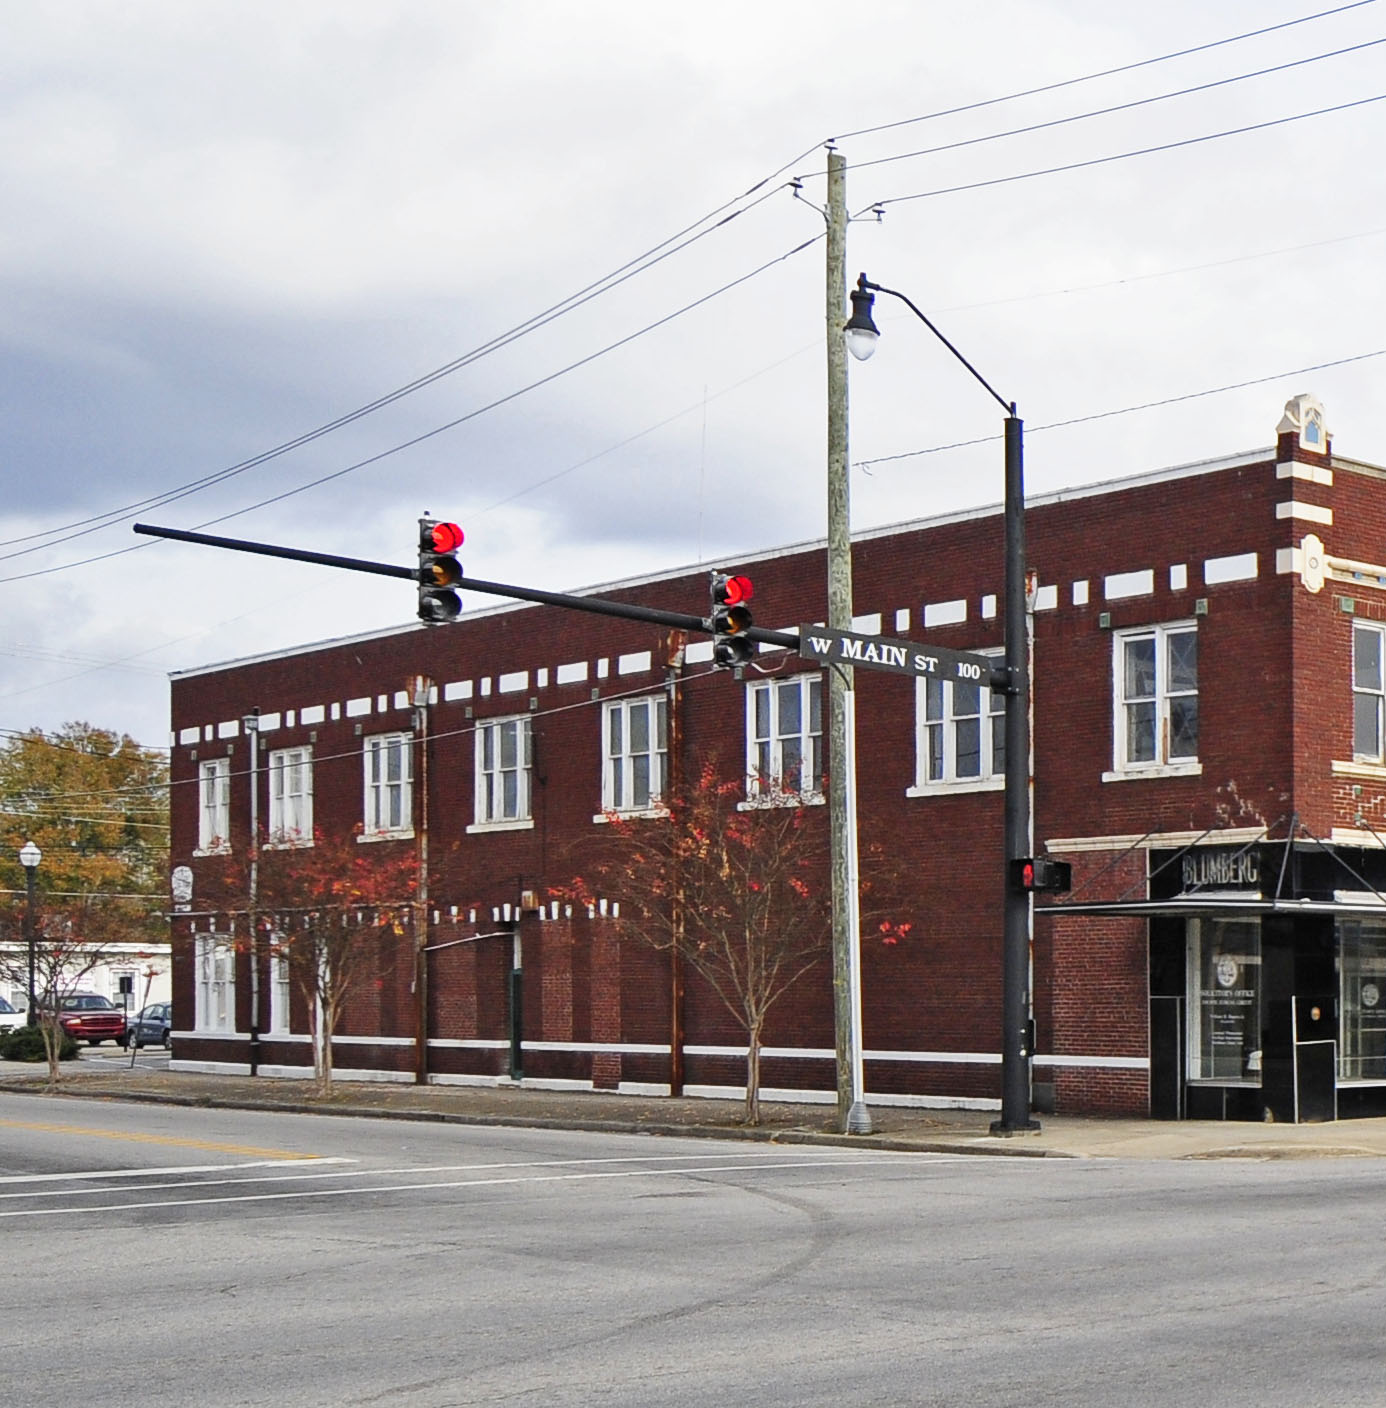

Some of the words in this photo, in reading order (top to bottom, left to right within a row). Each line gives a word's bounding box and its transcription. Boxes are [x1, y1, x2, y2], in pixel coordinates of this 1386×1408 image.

[809, 637, 832, 654] W
[840, 638, 908, 667] MAIN
[914, 655, 938, 673] ST
[957, 662, 981, 680] 100
[1182, 852, 1258, 885] BLUMBERG
